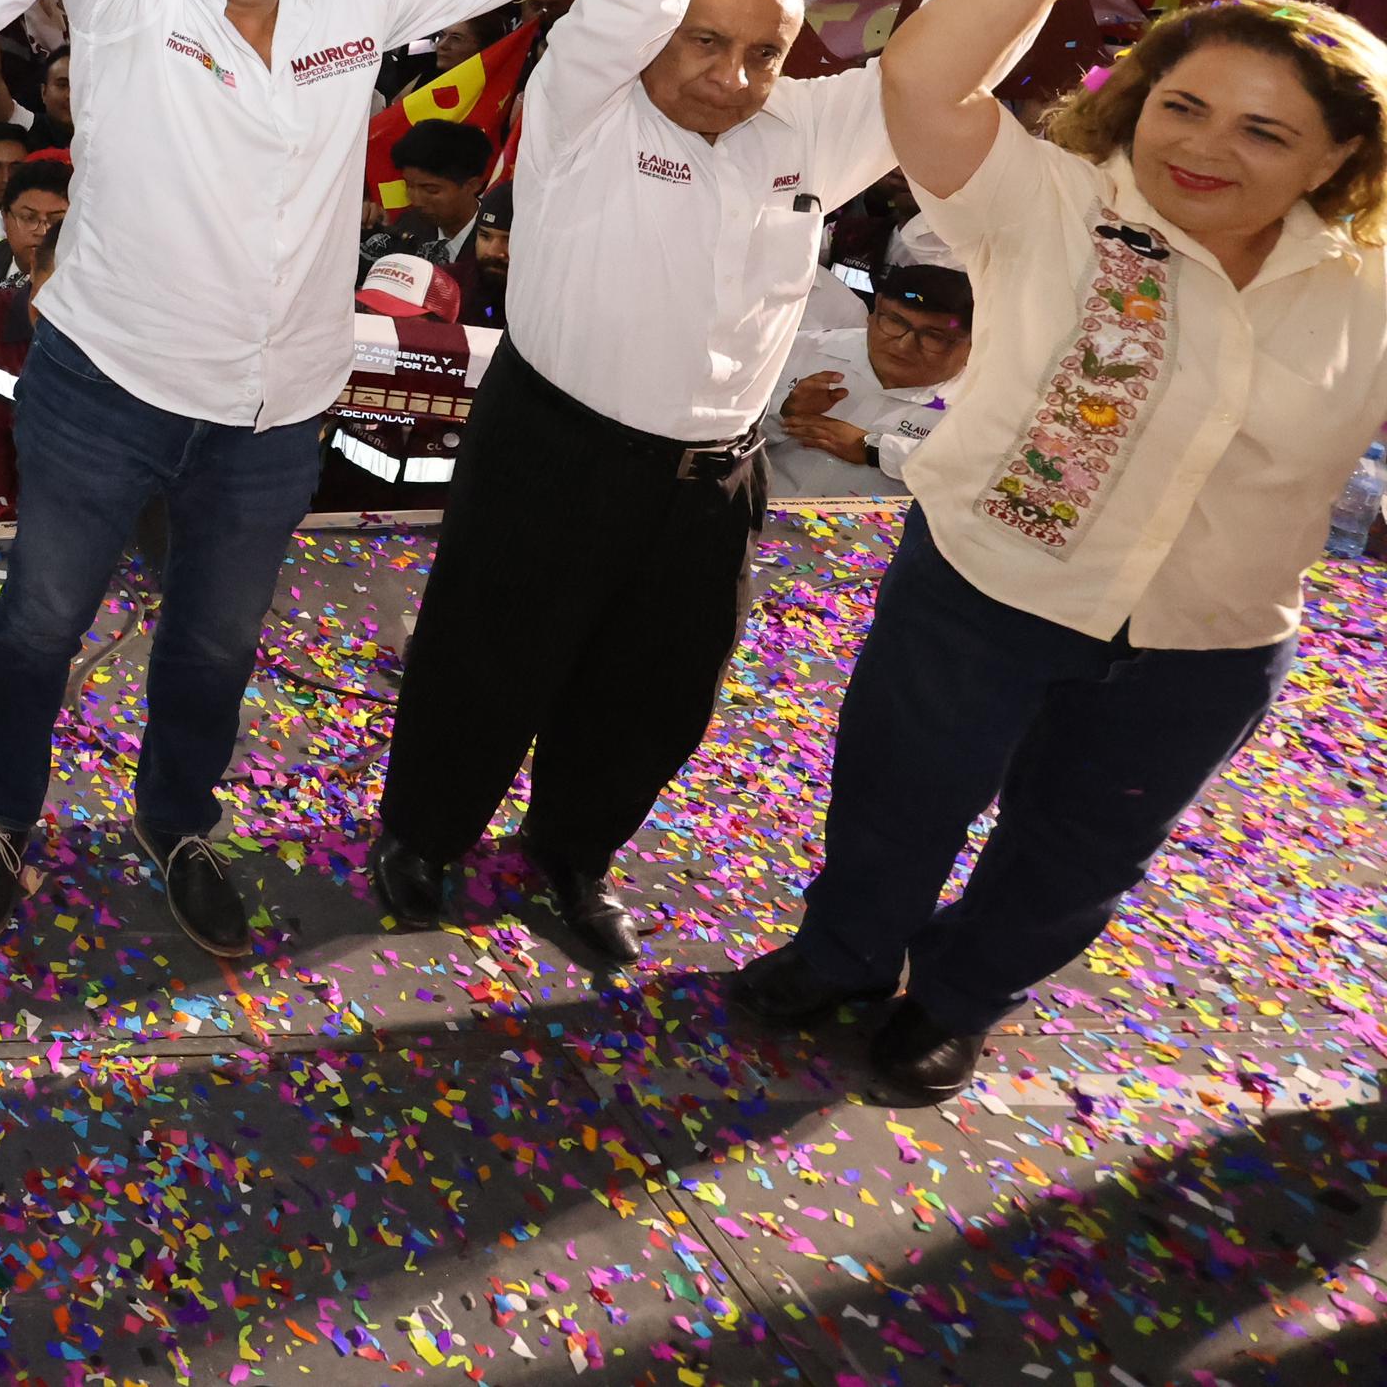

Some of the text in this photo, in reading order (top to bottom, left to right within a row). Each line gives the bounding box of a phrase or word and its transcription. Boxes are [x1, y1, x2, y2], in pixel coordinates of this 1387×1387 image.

[166, 37, 203, 62] morena
[290, 36, 376, 75] MAURICIO
[293, 51, 379, 83] CESPEDES PEREGRINA
[371, 346, 453, 365] ARMENTA Y
[394, 360, 423, 371] POR
[425, 364, 443, 375] LA
[446, 368, 467, 378] 4T
